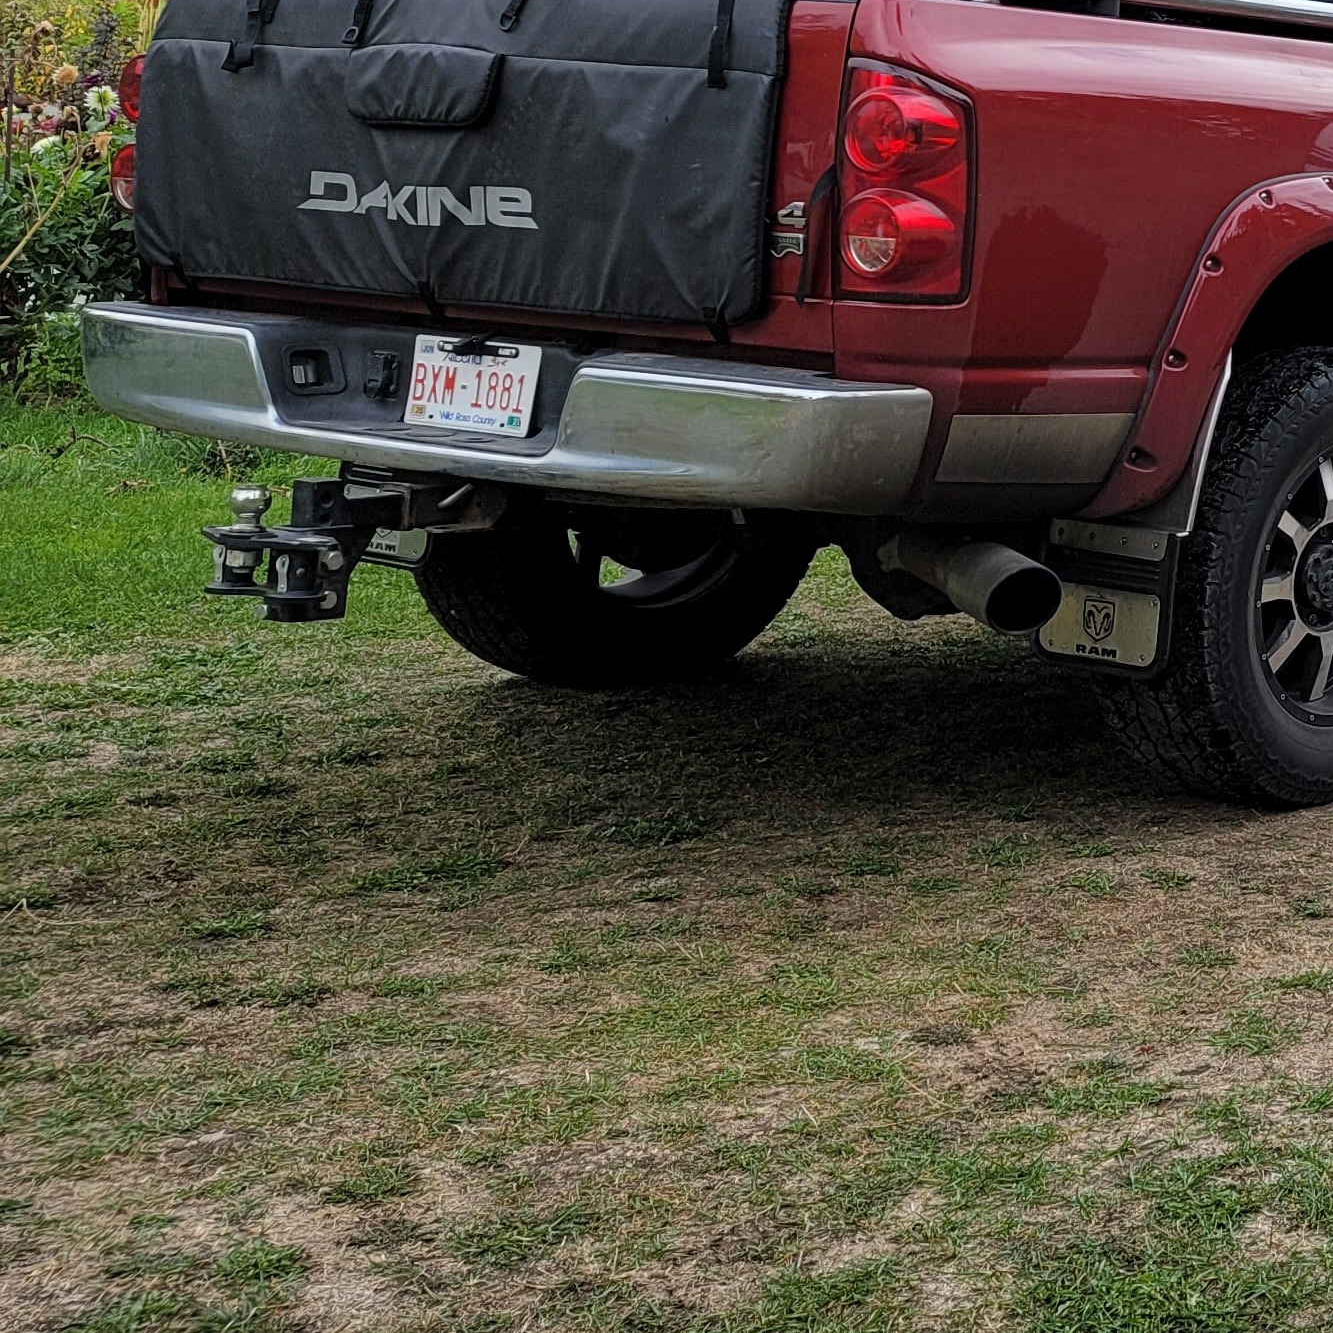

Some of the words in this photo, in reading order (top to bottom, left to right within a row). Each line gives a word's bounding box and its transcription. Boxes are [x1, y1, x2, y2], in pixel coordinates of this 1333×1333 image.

[296, 170, 539, 229] DAKINE
[412, 362, 526, 414] BXM-1881
[1075, 644, 1118, 659] RAM
